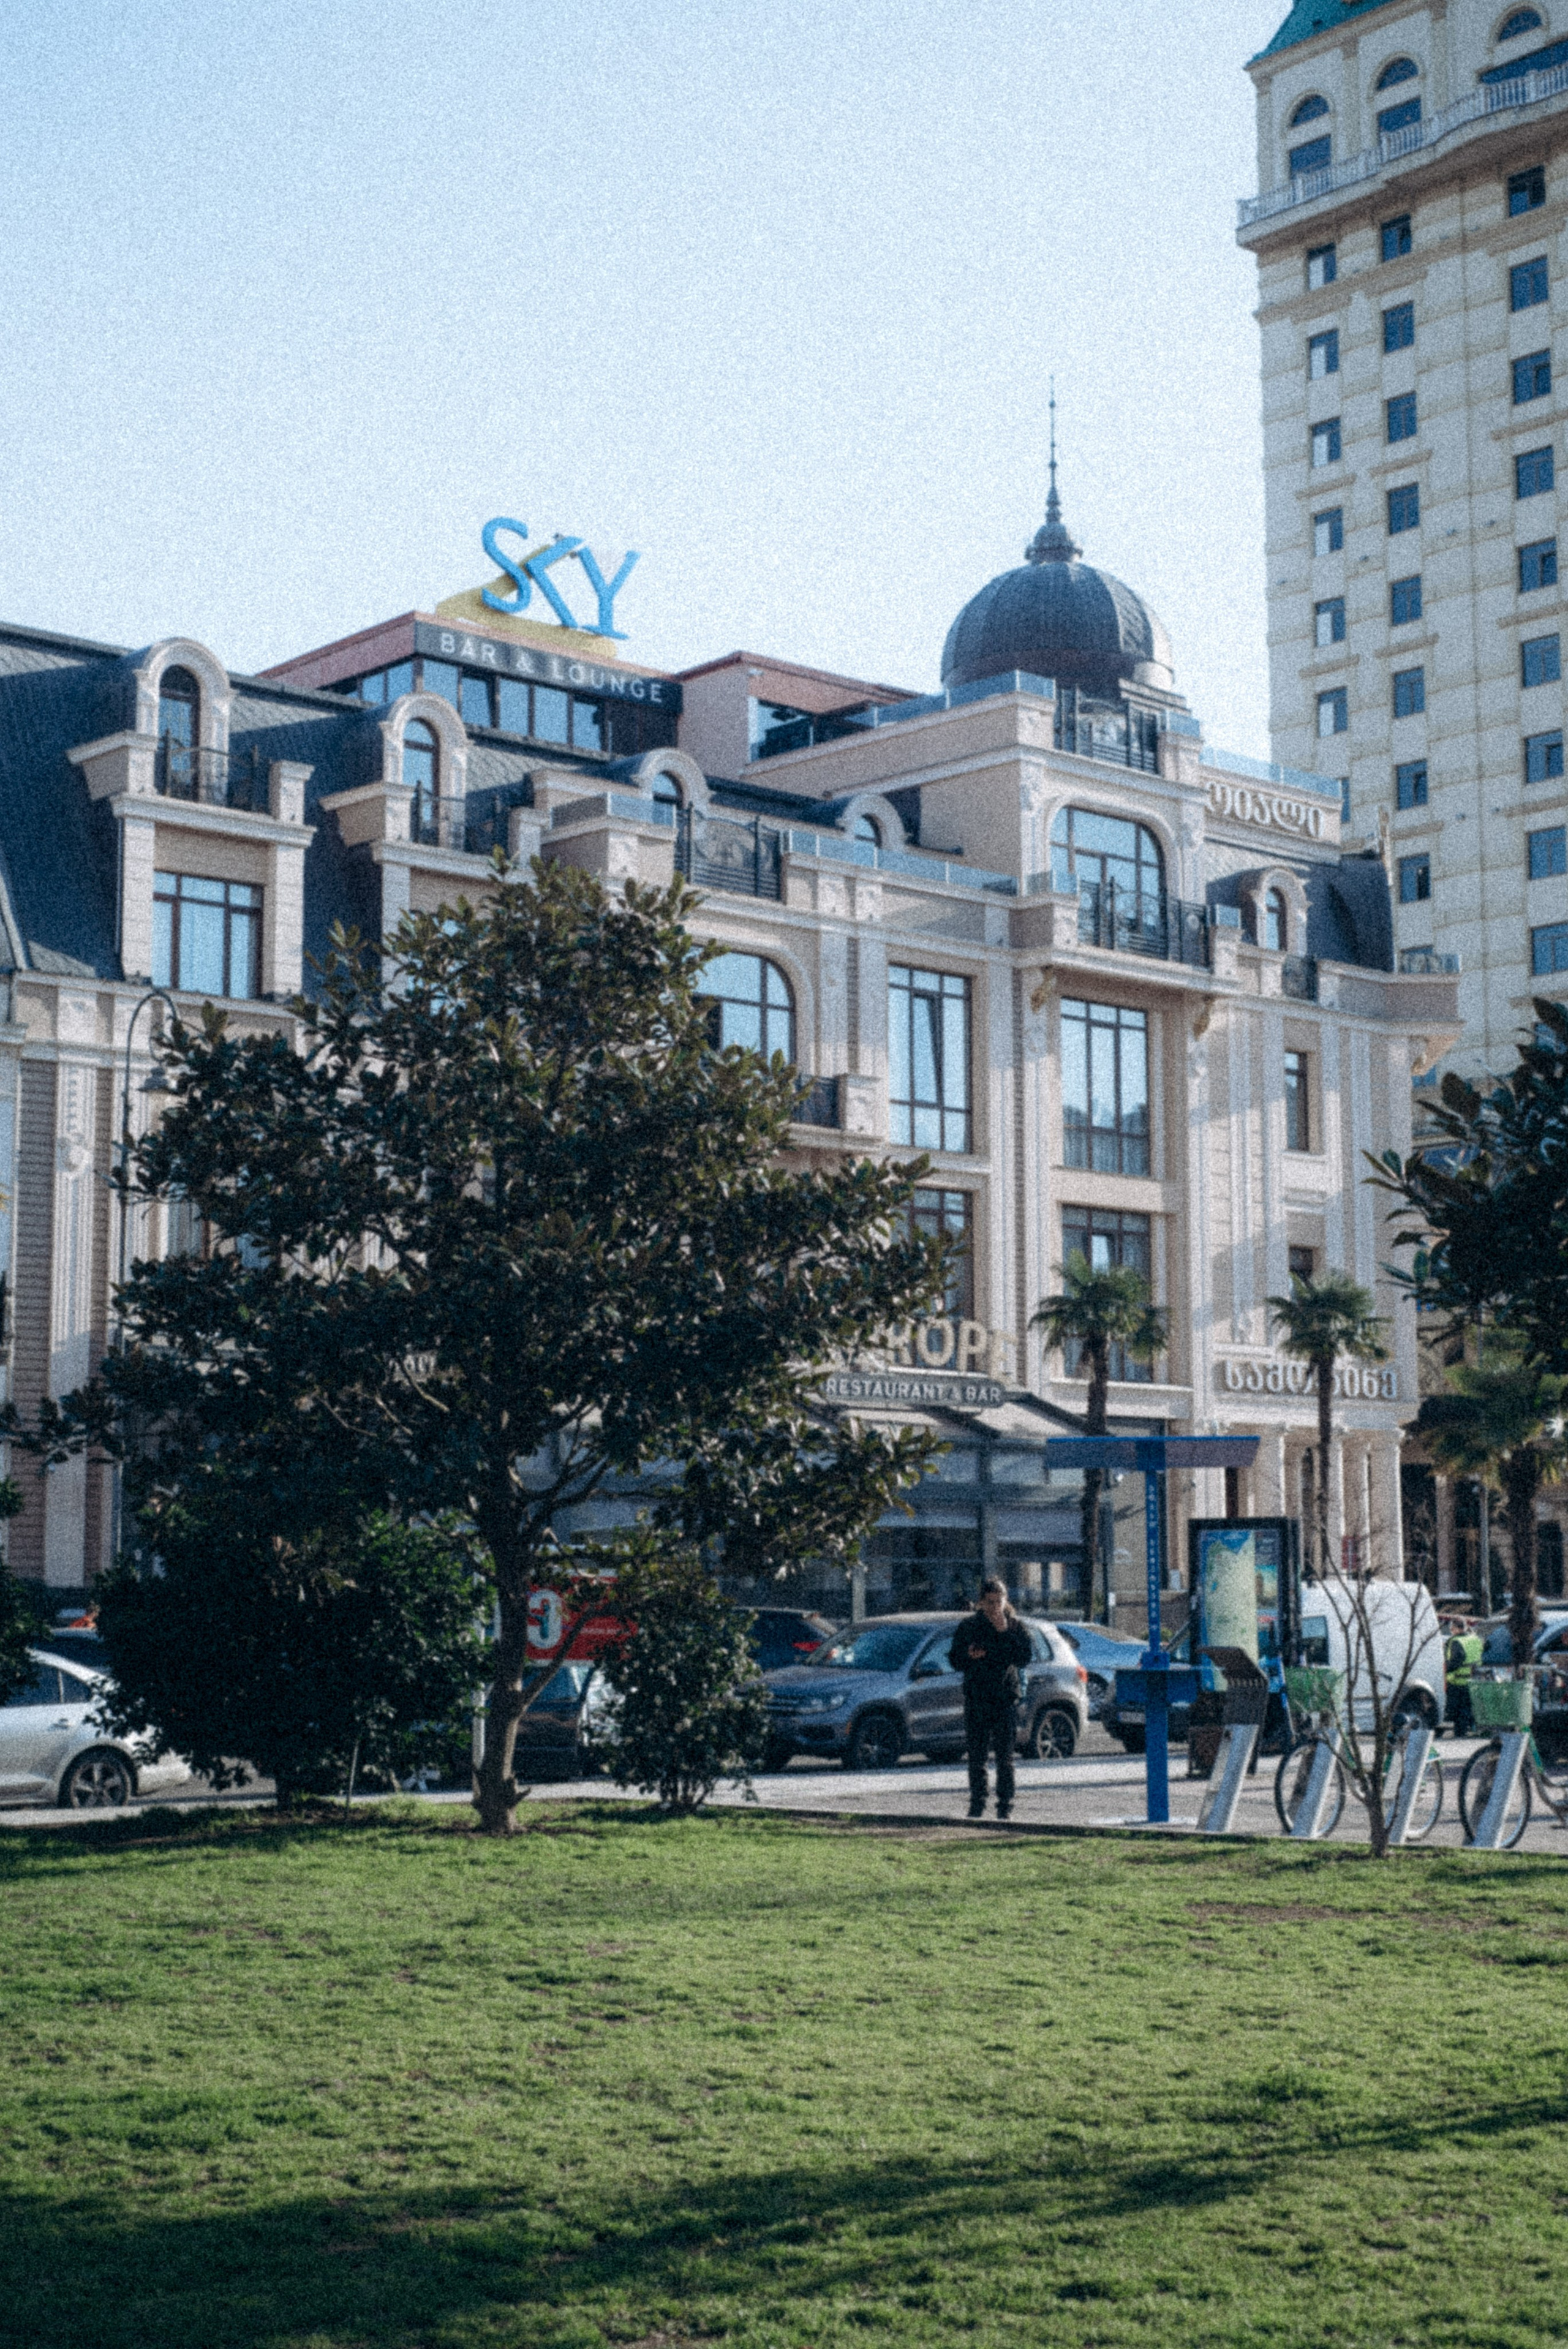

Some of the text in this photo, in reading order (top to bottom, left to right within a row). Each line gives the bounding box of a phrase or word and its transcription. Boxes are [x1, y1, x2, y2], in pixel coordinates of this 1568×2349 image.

[481, 516, 641, 639] SKY
[440, 632, 663, 703] BAR & LOUNGE
[887, 1316, 1018, 1382] ROPE
[827, 1378, 944, 1400] RESTAURANT
[966, 1385, 1001, 1403] BAR
